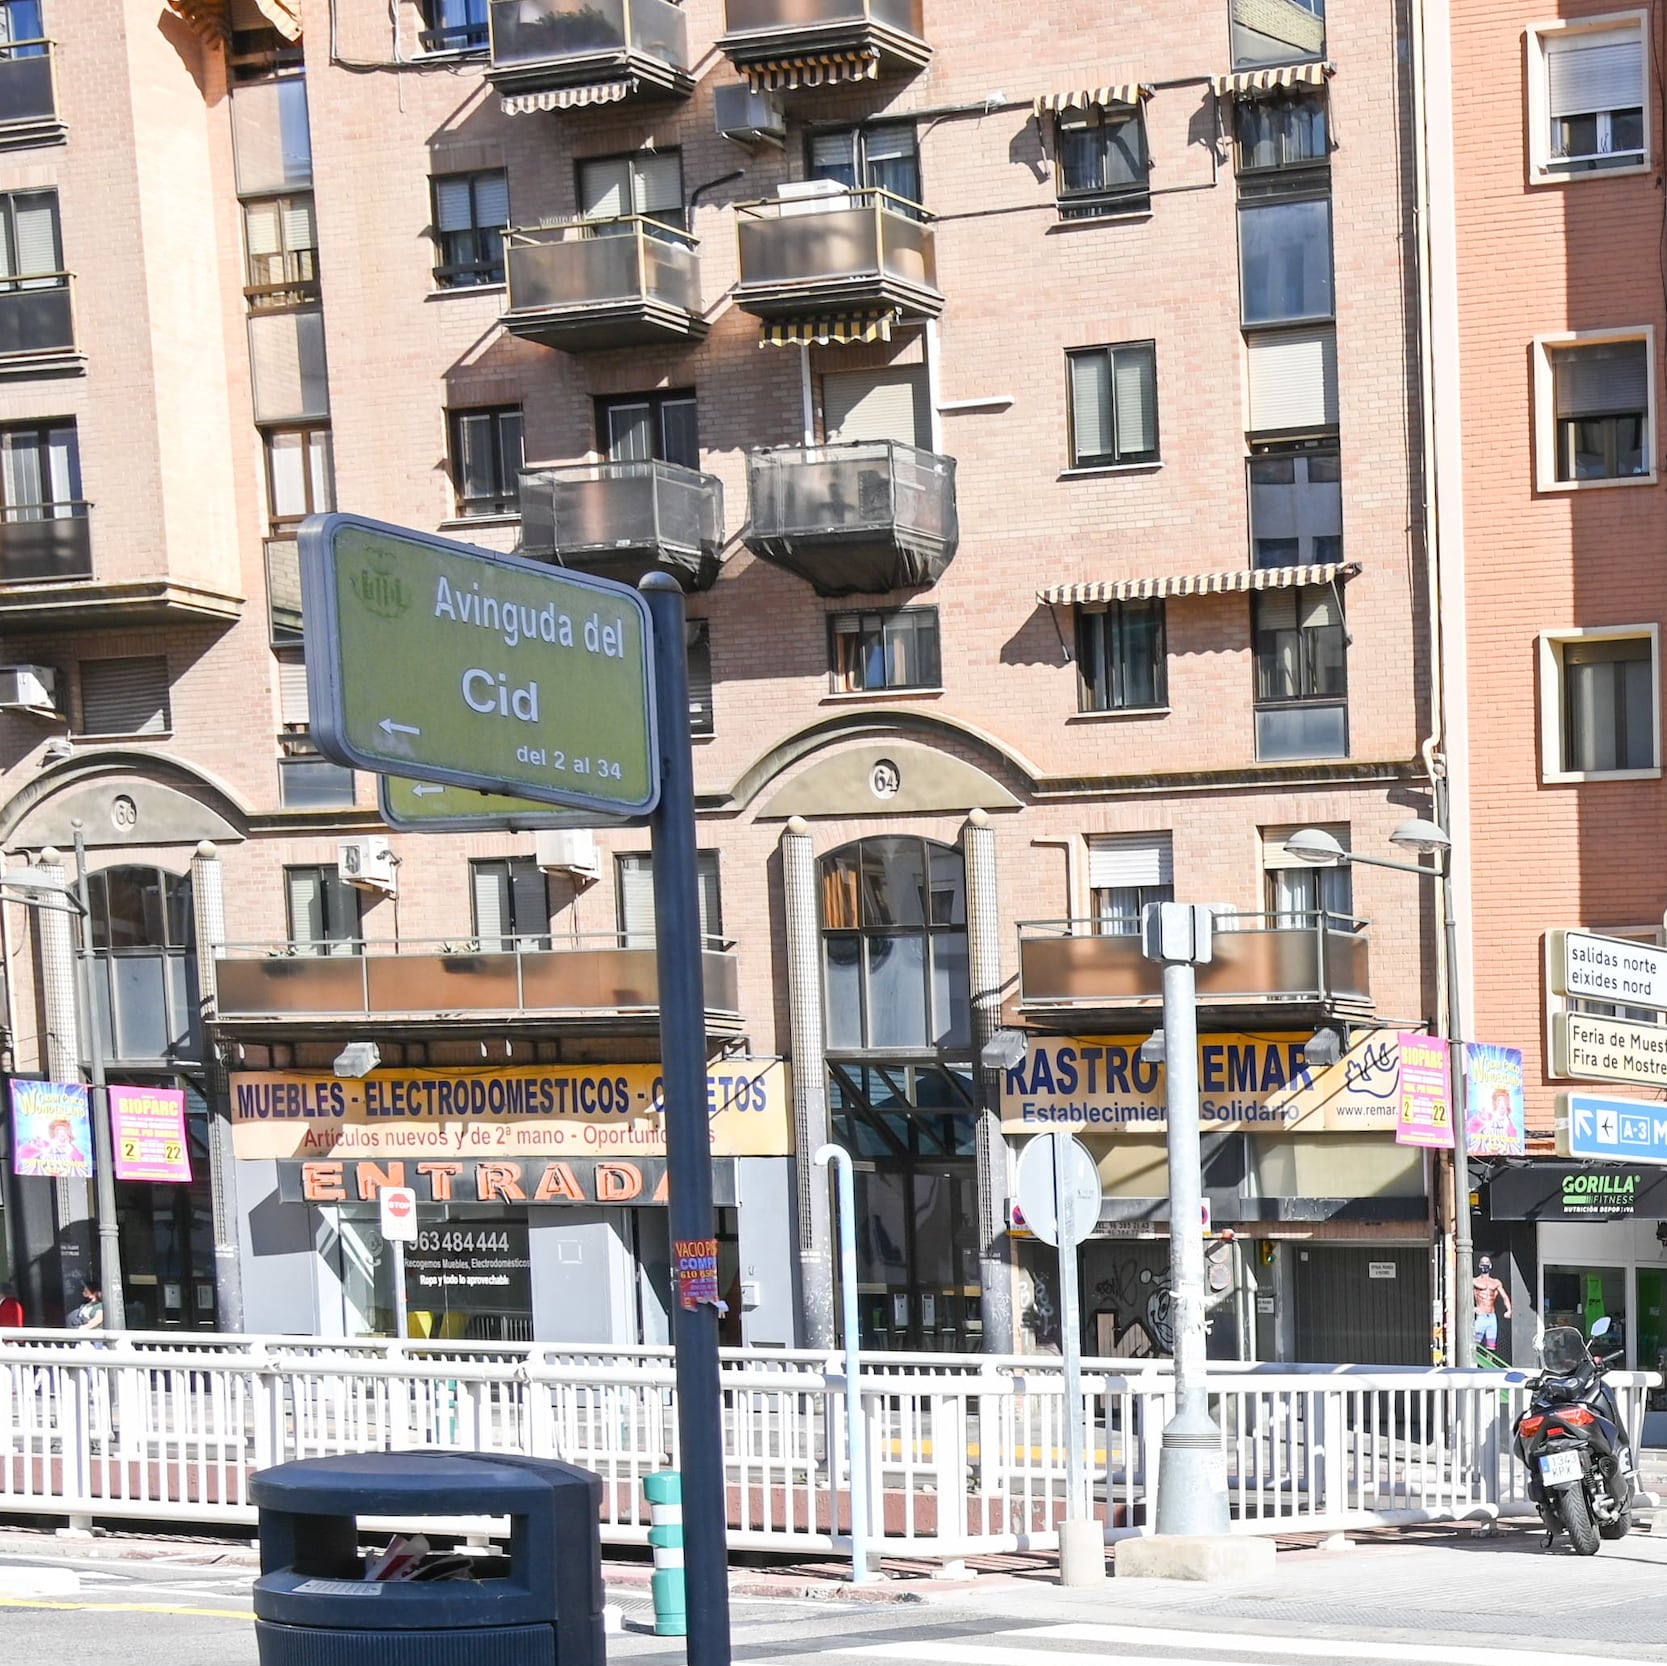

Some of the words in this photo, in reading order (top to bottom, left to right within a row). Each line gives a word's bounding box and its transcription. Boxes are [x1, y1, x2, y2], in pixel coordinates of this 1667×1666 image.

[434, 576, 573, 647] Avinguda
[583, 617, 624, 658] del
[460, 667, 540, 723] Cid
[517, 746, 546, 766] del
[553, 751, 566, 770] 2
[573, 755, 590, 775] al
[597, 759, 622, 780] 34
[1572, 947, 1618, 967] salidas
[1623, 958, 1657, 975] norte
[1572, 968, 1618, 990] eixides
[1623, 979, 1652, 996] nord
[1573, 1025, 1605, 1046] Feria
[1609, 1034, 1625, 1048] de
[1573, 1048, 1598, 1067] Fira
[1602, 1054, 1618, 1069] de
[1006, 1046, 1159, 1096] RASTRO
[1197, 1044, 1315, 1093] EMAR
[119, 1098, 178, 1116] BIOPARC
[237, 1081, 344, 1119] MUEBLES
[365, 1077, 629, 1117] ELECTRODOMESTICOS
[1202, 1100, 1300, 1121] Solidario
[1404, 1101, 1410, 1118] 2
[1433, 1105, 1446, 1122] 22
[304, 1127, 380, 1147] Artículos
[385, 1131, 448, 1147] nuevos
[455, 1131, 464, 1149] y
[471, 1126, 491, 1146] de
[517, 1129, 564, 1145] mano
[1623, 1121, 1647, 1140] A-3
[125, 1143, 135, 1157] 2
[166, 1146, 181, 1160] 22
[388, 1201, 411, 1209] STOP
[1593, 1195, 1634, 1205] FITNESS
[675, 1241, 705, 1257] VACIO
